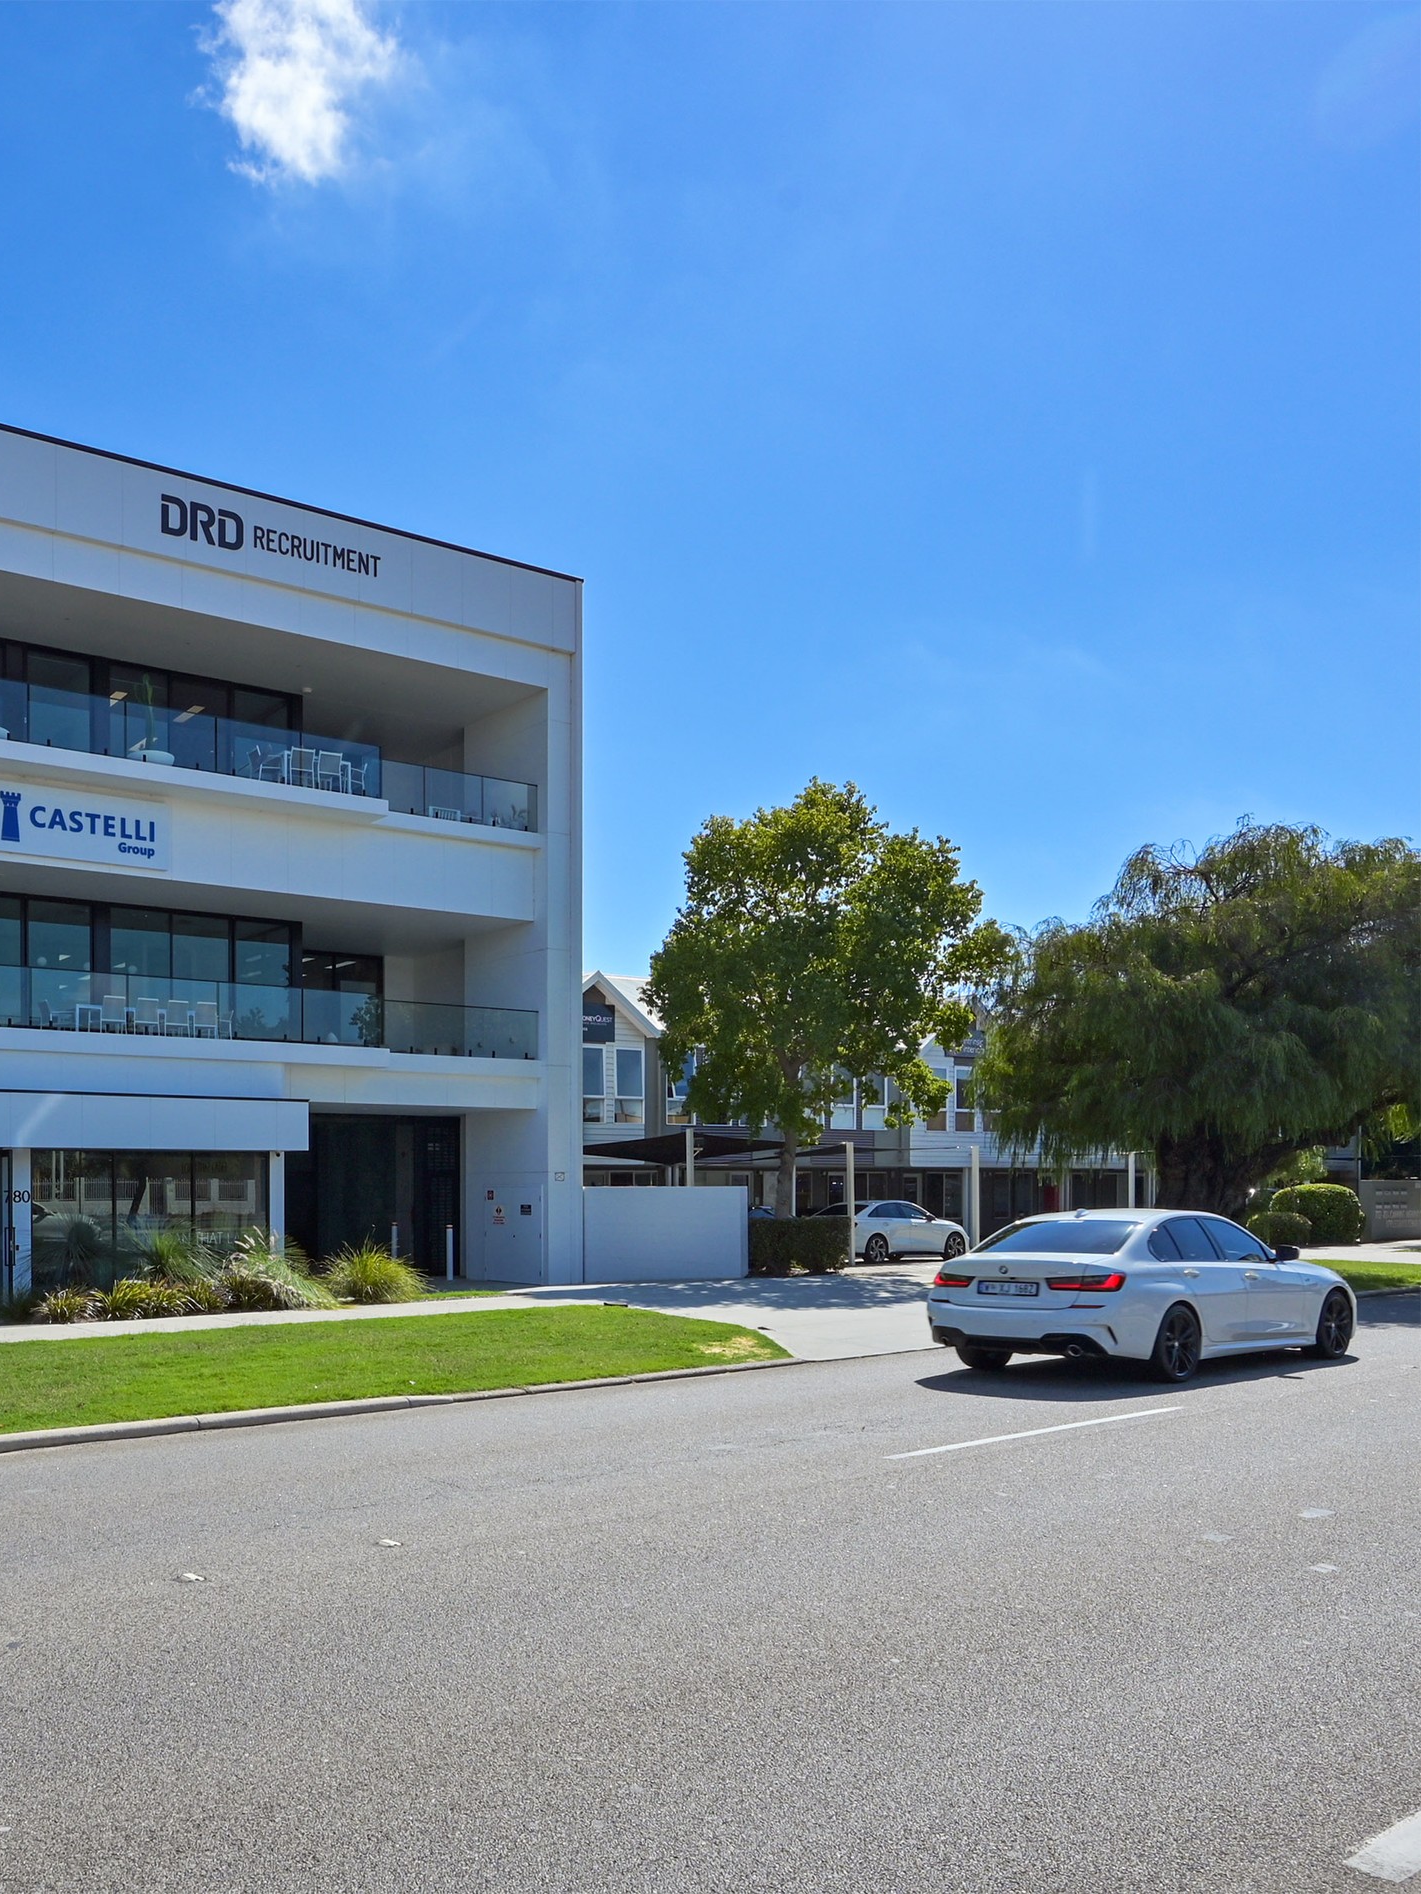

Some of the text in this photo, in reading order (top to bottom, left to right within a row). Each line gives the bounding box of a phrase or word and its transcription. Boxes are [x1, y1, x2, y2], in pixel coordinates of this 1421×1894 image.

[161, 493, 381, 578] DRD RECRUITMENT
[29, 806, 155, 842] CASTELLI
[118, 842, 155, 859] Group
[582, 1014, 613, 1023] ONEYQUEST
[3, 1190, 31, 1203] 780
